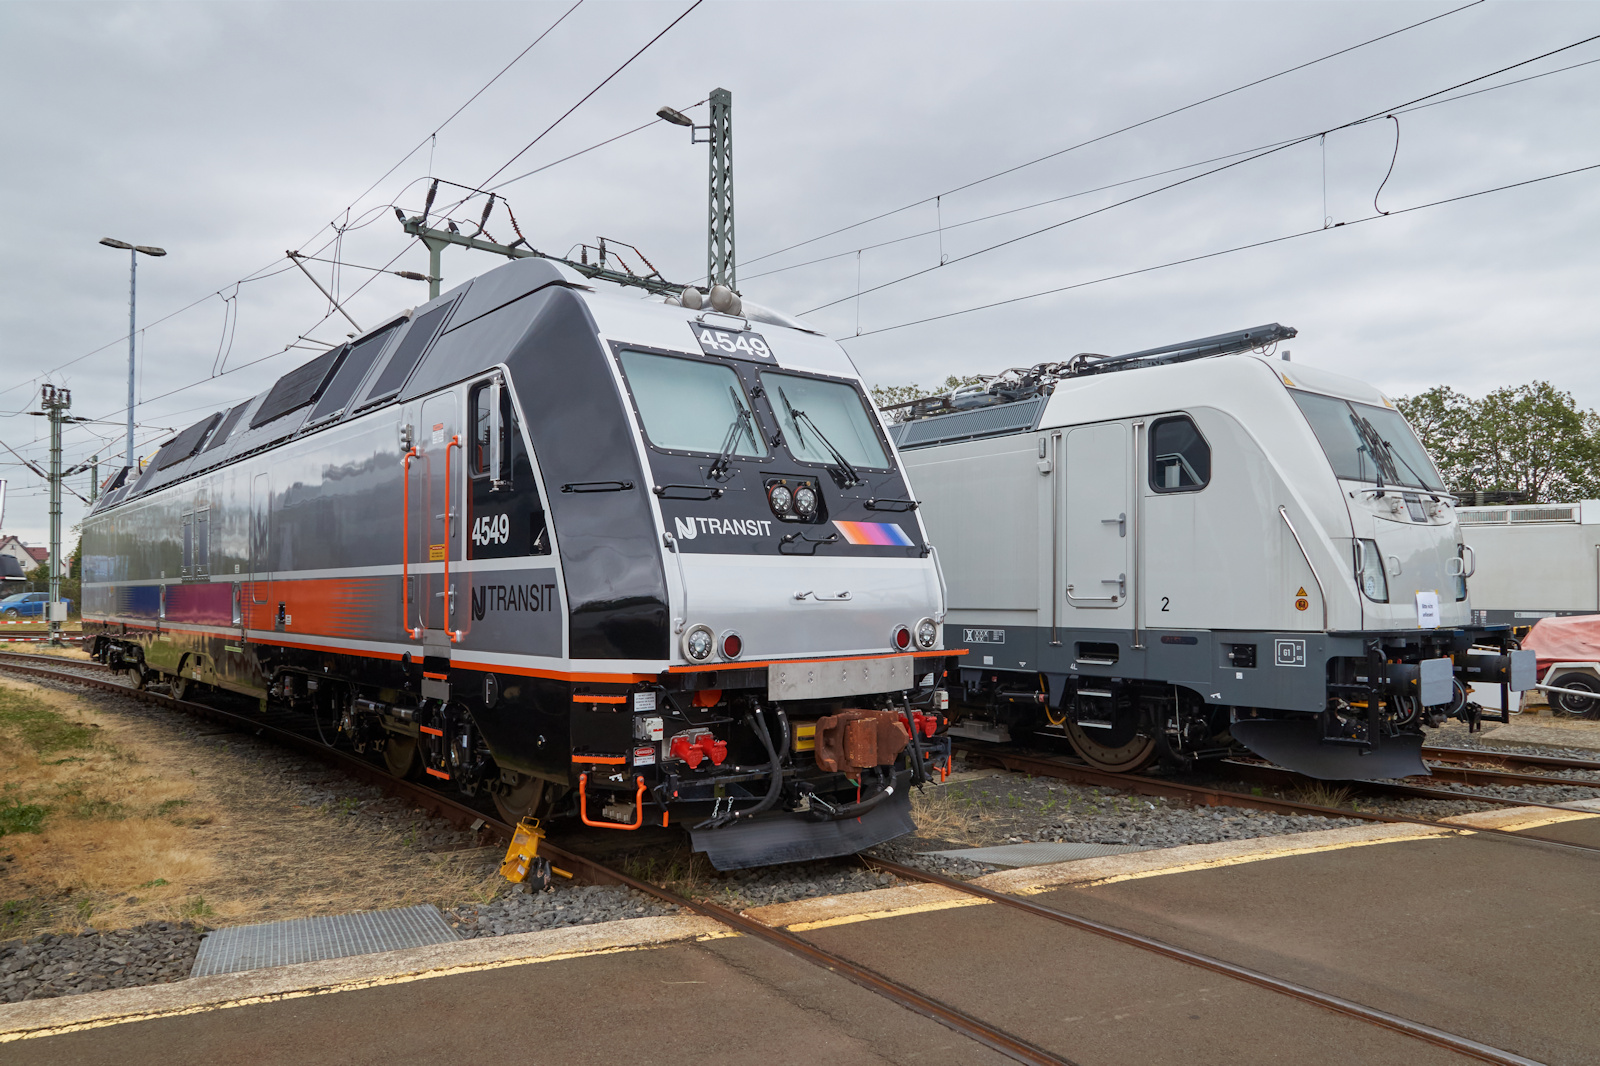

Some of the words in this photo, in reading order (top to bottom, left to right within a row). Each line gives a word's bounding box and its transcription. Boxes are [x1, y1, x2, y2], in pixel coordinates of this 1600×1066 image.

[700, 329, 771, 358] 4549
[472, 513, 510, 546] 4549
[674, 516, 698, 540] NJ
[695, 517, 772, 537] TRANSIT
[471, 585, 487, 621] NJ
[487, 583, 556, 612] TRANSIT
[1161, 596, 1170, 612] 2
[1283, 648, 1291, 657] G1
